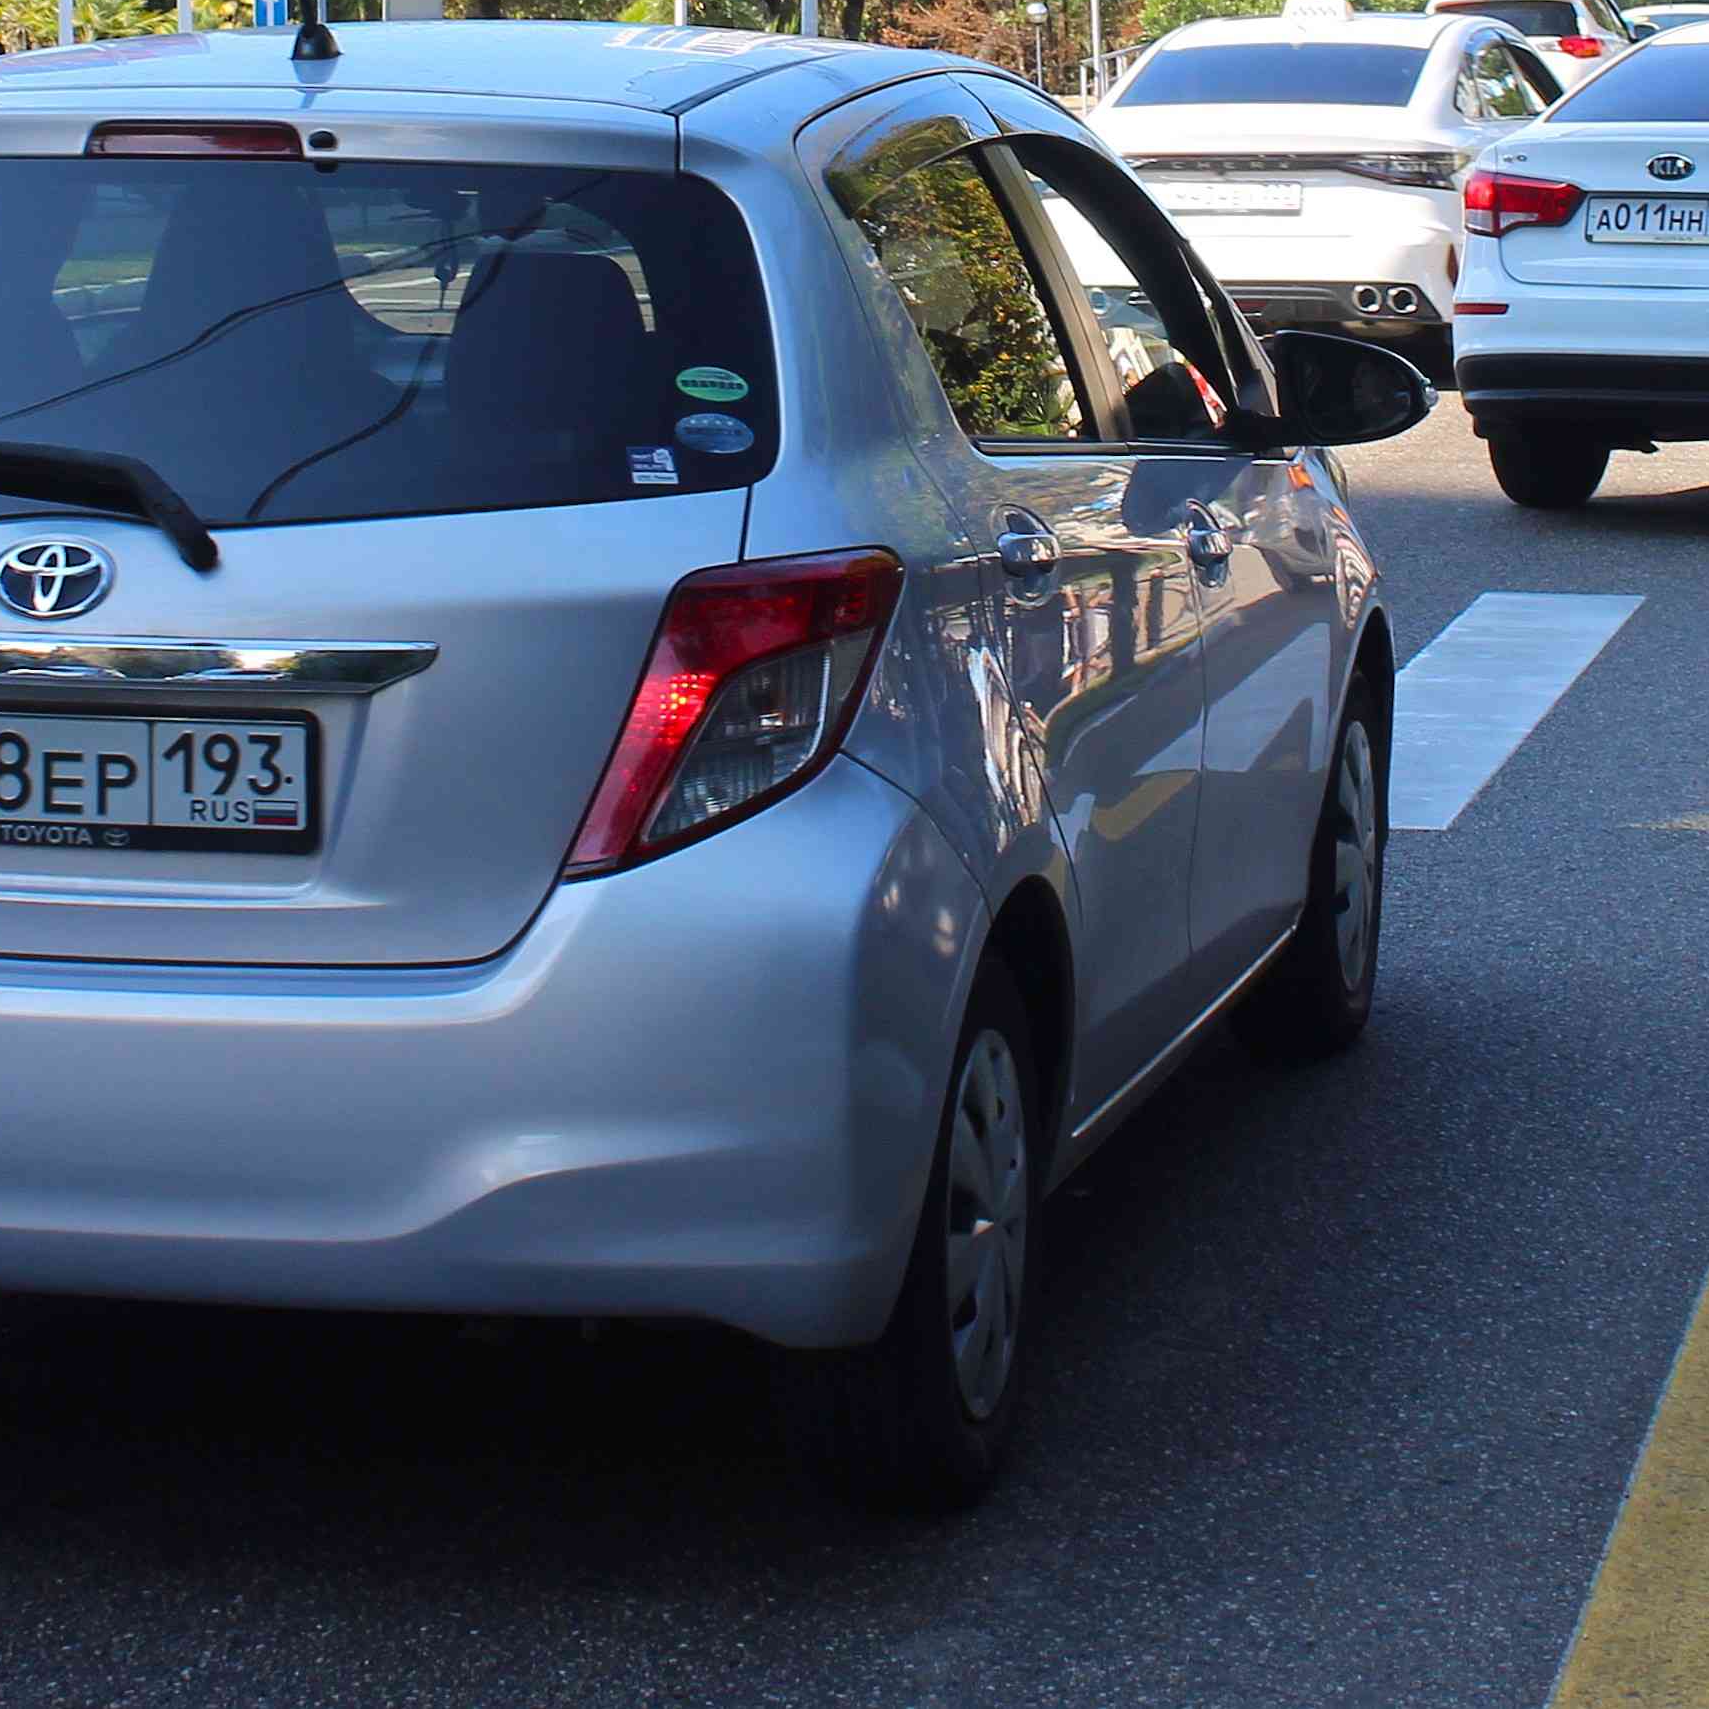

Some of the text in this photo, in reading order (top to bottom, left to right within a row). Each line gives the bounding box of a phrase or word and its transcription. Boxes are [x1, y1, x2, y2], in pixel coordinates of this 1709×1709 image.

[1653, 159, 1687, 176] KIA
[162, 730, 284, 796] 193
[190, 800, 250, 824] RUS
[0, 824, 94, 846] TOYOTA
